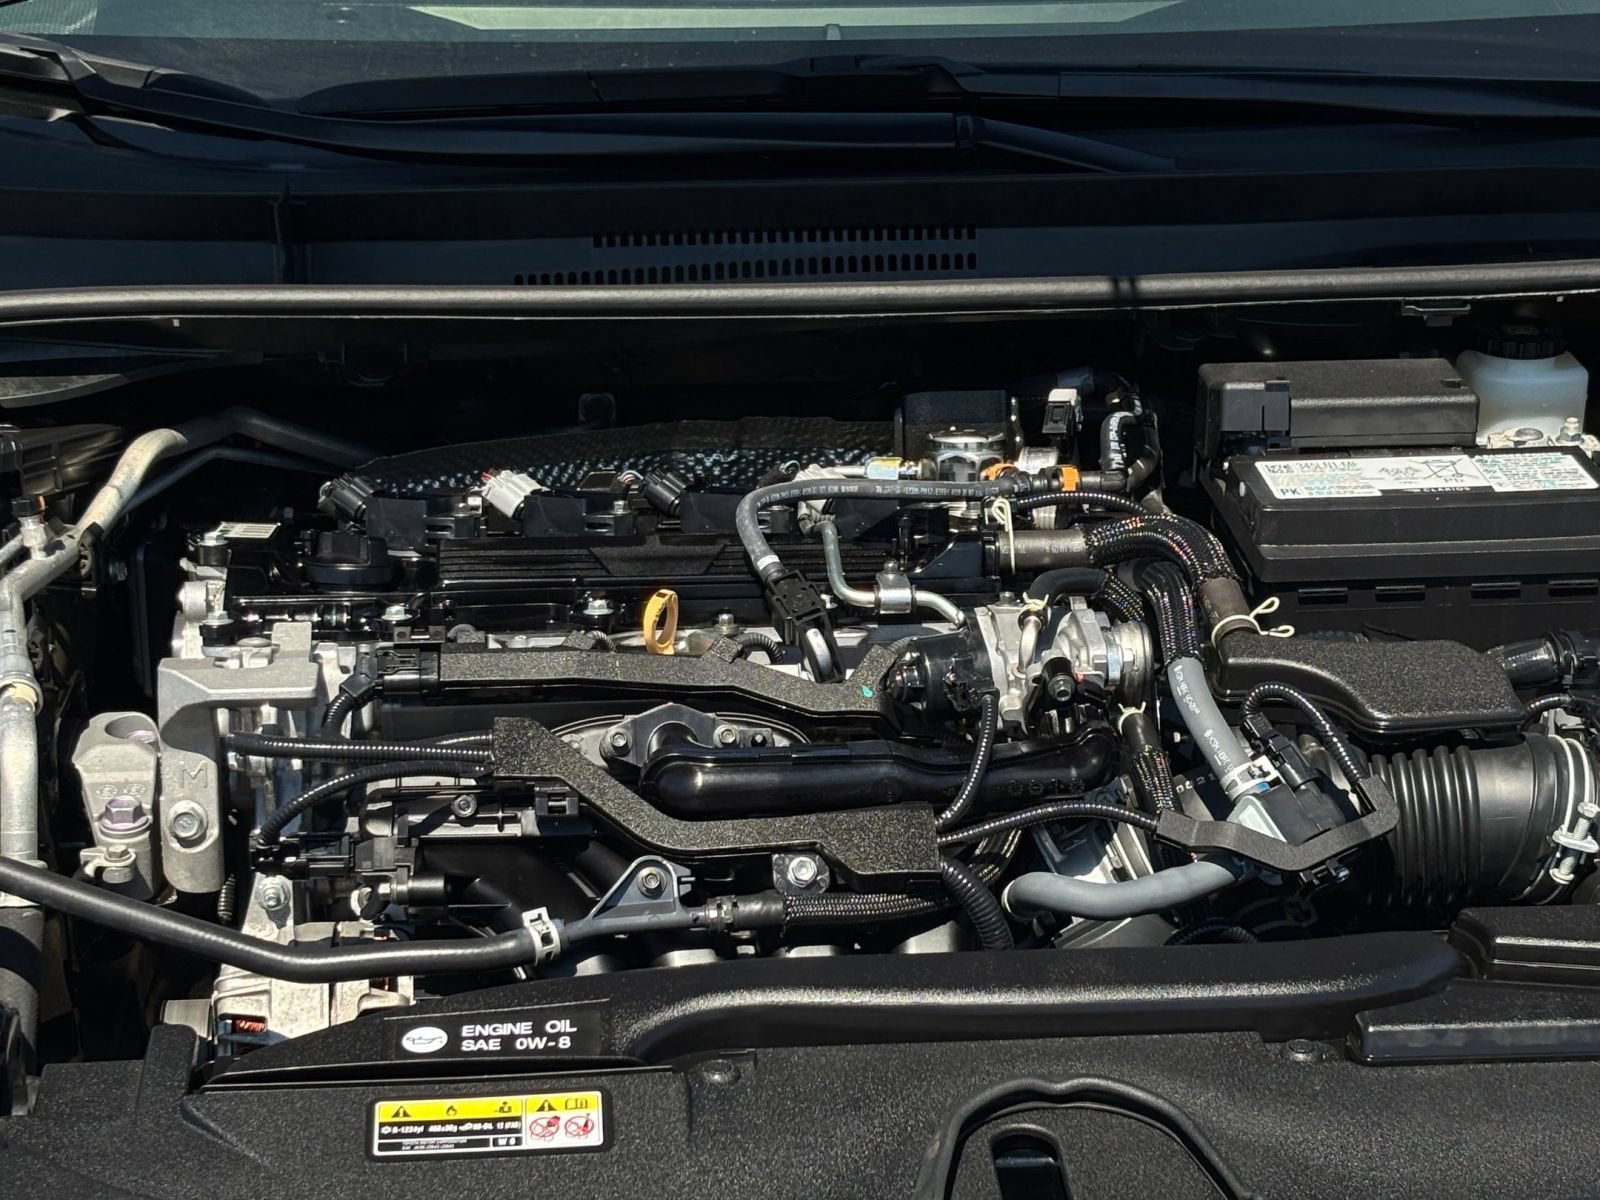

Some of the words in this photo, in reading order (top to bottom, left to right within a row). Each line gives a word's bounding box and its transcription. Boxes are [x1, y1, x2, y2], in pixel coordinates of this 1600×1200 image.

[1280, 488, 1301, 496] PK
[180, 760, 208, 788] M
[461, 1022, 533, 1037] ENGINE
[545, 1019, 578, 1034] OIL
[461, 1040, 502, 1052] SAE
[515, 1036, 572, 1049] 0W-8
